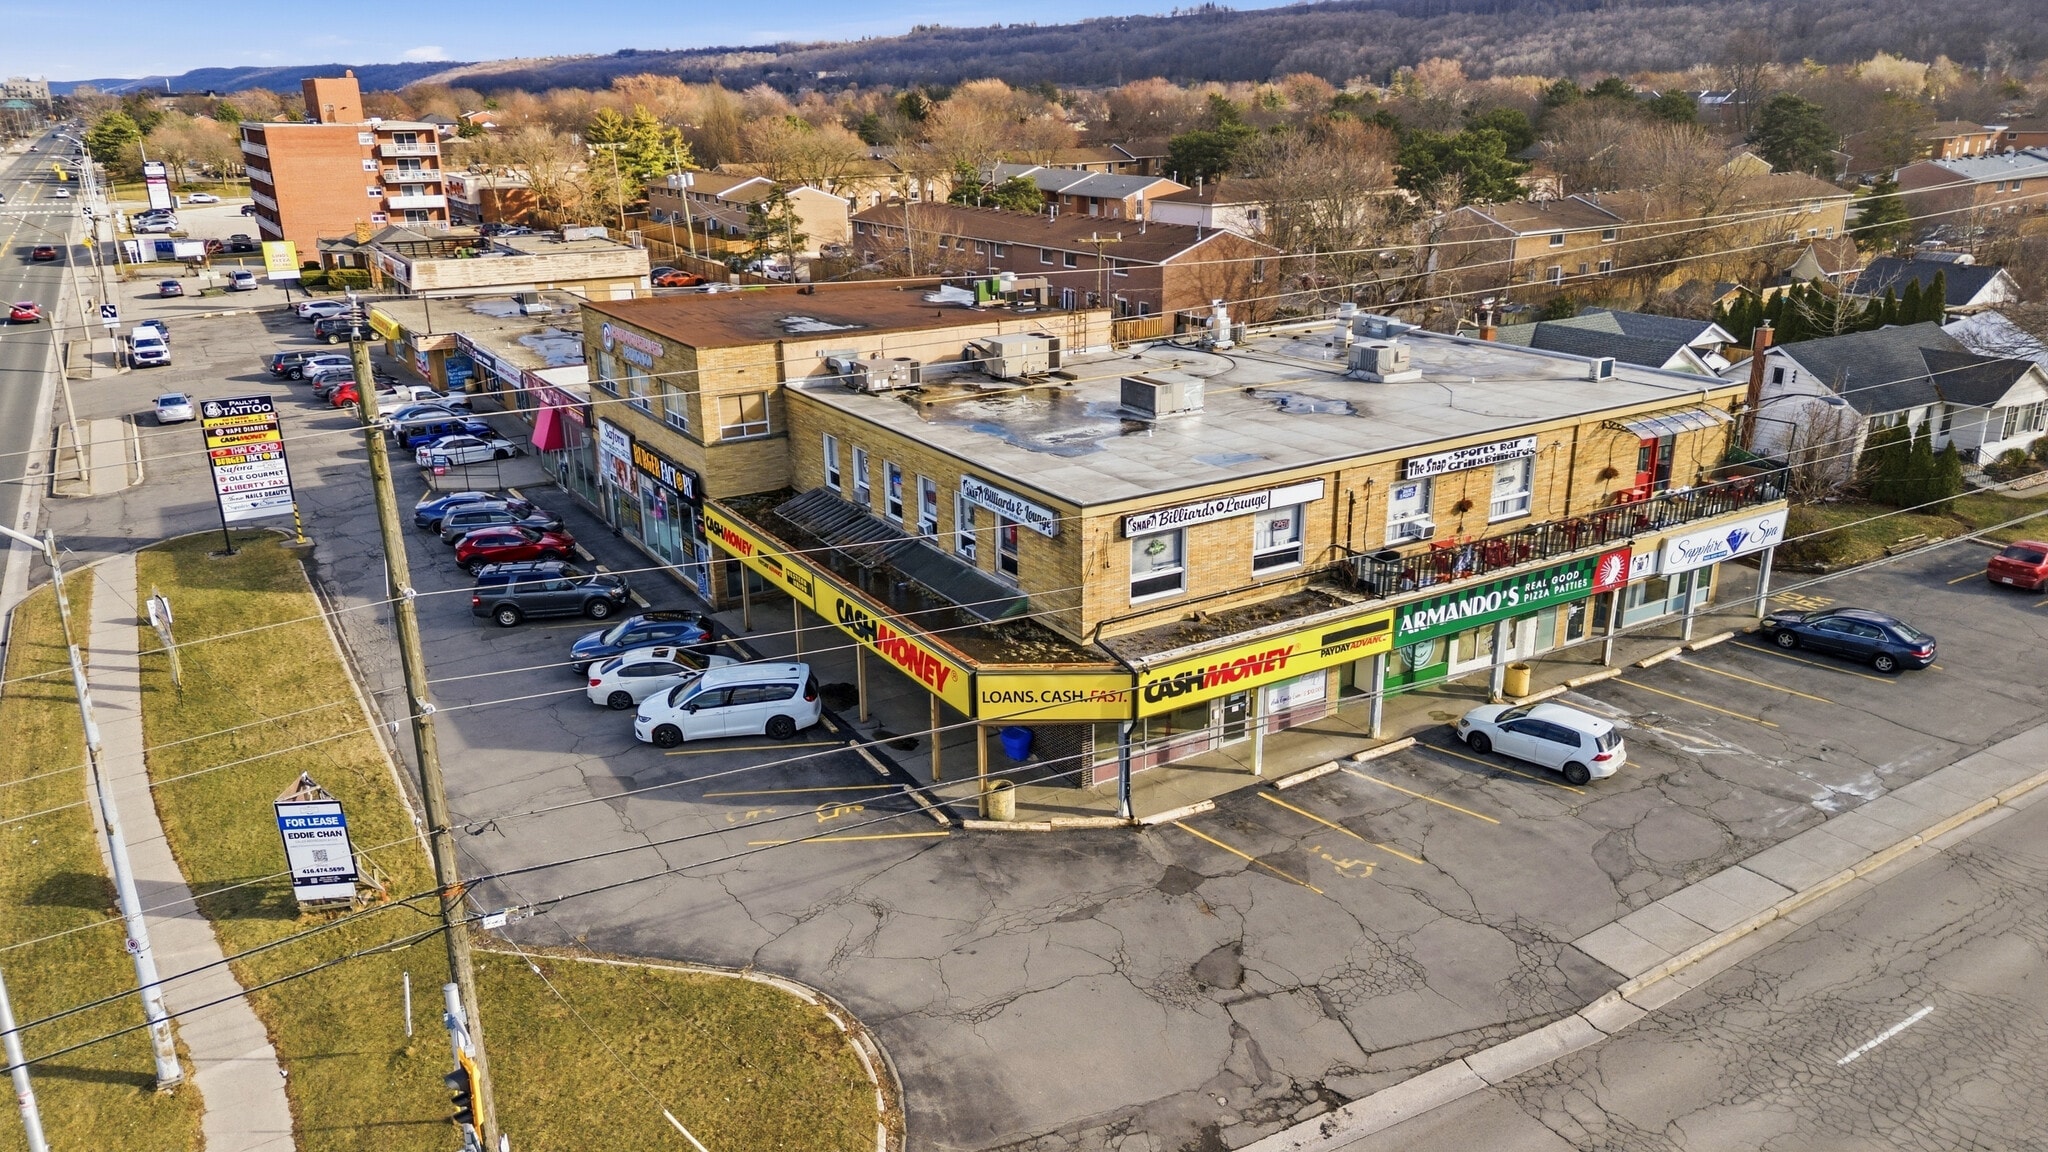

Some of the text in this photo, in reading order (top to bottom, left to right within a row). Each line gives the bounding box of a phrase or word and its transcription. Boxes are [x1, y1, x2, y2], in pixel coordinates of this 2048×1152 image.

[223, 403, 272, 416] TATTOO
[230, 399, 260, 407] PAULY'S
[221, 433, 268, 443] CASHMONEY
[227, 424, 269, 435] VAPE DIARIES
[249, 443, 279, 453] ORCHID
[215, 455, 246, 466] BURGER
[632, 443, 661, 479] BURGER
[1408, 458, 1447, 477] The Snap
[229, 469, 284, 482] OLE GOURMET
[230, 479, 285, 491] LIBERTY TAX
[246, 492, 263, 500] NAILS
[265, 489, 288, 498] BEAUTY
[983, 487, 1015, 513] Billiards
[1015, 501, 1023, 515] &
[1024, 505, 1052, 531] Lounge
[1132, 494, 1268, 532] SNAP Billiards Lounge
[705, 515, 754, 557] CASHMONEY
[1670, 539, 1723, 564] Sapphire
[1750, 519, 1778, 544] Spa
[1524, 570, 1580, 592] REAL GOOD
[1524, 578, 1588, 603] PIZZA PATTIES
[1398, 586, 1519, 637] ARMANDO'S
[835, 597, 951, 693] CASHMONEY
[1320, 634, 1387, 658] PAYDAYADVANC
[1143, 645, 1294, 704] CASHMONEY
[981, 689, 1128, 704] LOANS. CASH. FAST.
[285, 816, 340, 827] FOR LEASE
[287, 830, 343, 840] EDDIE CHAN
